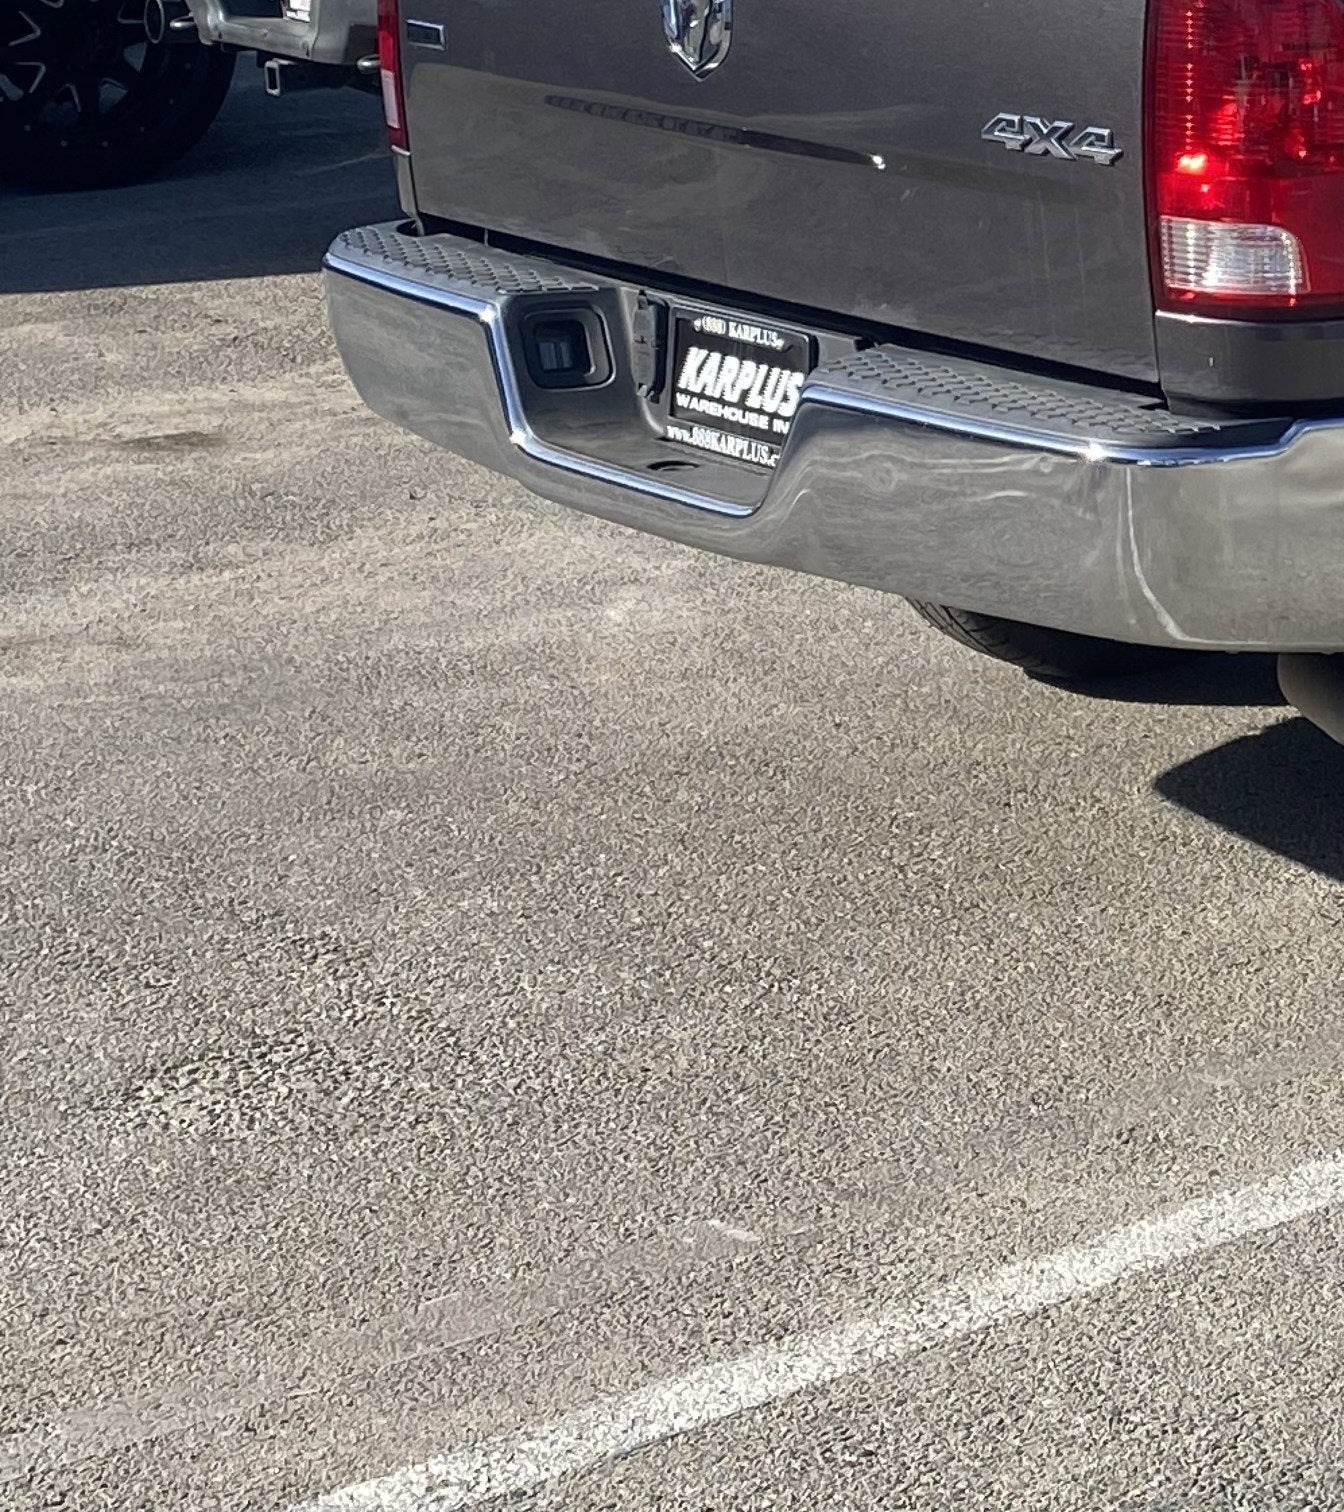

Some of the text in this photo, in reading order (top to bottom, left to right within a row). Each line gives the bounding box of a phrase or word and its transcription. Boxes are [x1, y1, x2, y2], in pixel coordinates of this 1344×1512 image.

[728, 321, 778, 348] KARPLUS
[677, 346, 805, 417] KARPLUS
[675, 391, 769, 430] WAREHOUSE
